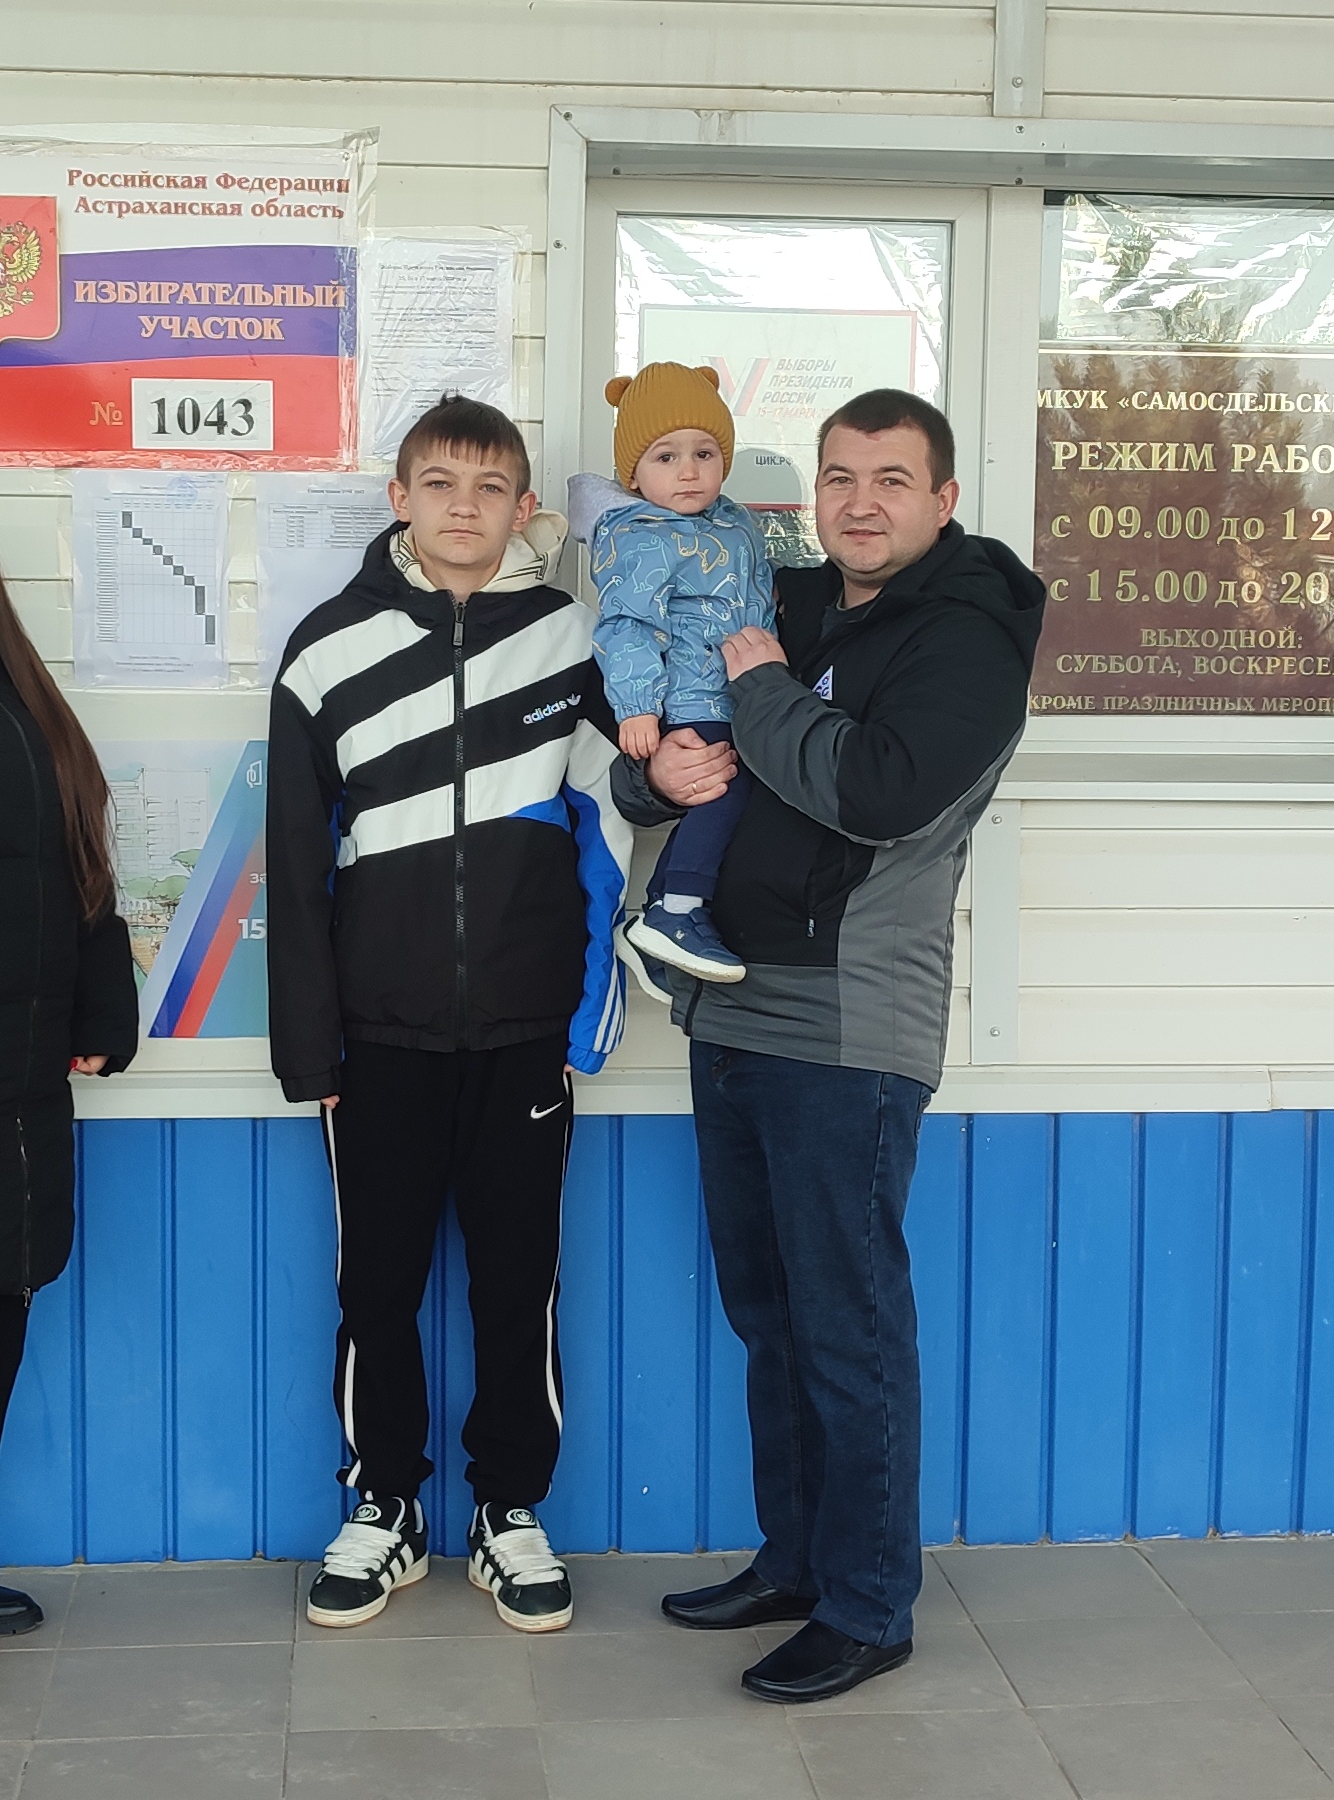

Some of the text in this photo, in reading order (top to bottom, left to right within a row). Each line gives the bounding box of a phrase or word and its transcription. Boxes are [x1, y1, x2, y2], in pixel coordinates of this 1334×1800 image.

[67, 169, 351, 196] Российская Федерации
[74, 196, 345, 219] Астраханская область
[73, 279, 347, 308] ИЗБИРАТЕЛЬНЫЙ
[138, 315, 285, 341] УЧАСТОК
[776, 359, 836, 372] ВЫБОРЫ
[768, 375, 854, 389] ПРЕЗИДЕНТА
[762, 391, 817, 405] РОССИИ
[1037, 389, 1108, 410] МКУК
[89, 396, 255, 437] № 1043
[1051, 440, 1218, 472] РЕЖИМ
[1051, 515, 1071, 538] с
[1088, 505, 1210, 540] 09.00
[1217, 517, 1265, 546] до
[1049, 578, 1069, 602] с
[1086, 568, 1208, 603] 15.00
[1214, 580, 1263, 609] до
[1140, 625, 1303, 651] ВЫХОДНОЙ:
[523, 700, 567, 725] adidas
[1029, 694, 1096, 710] КРОМЕ
[1103, 696, 1255, 713] ПРАЗДНИЧНЫХ
[238, 918, 267, 940] 15
